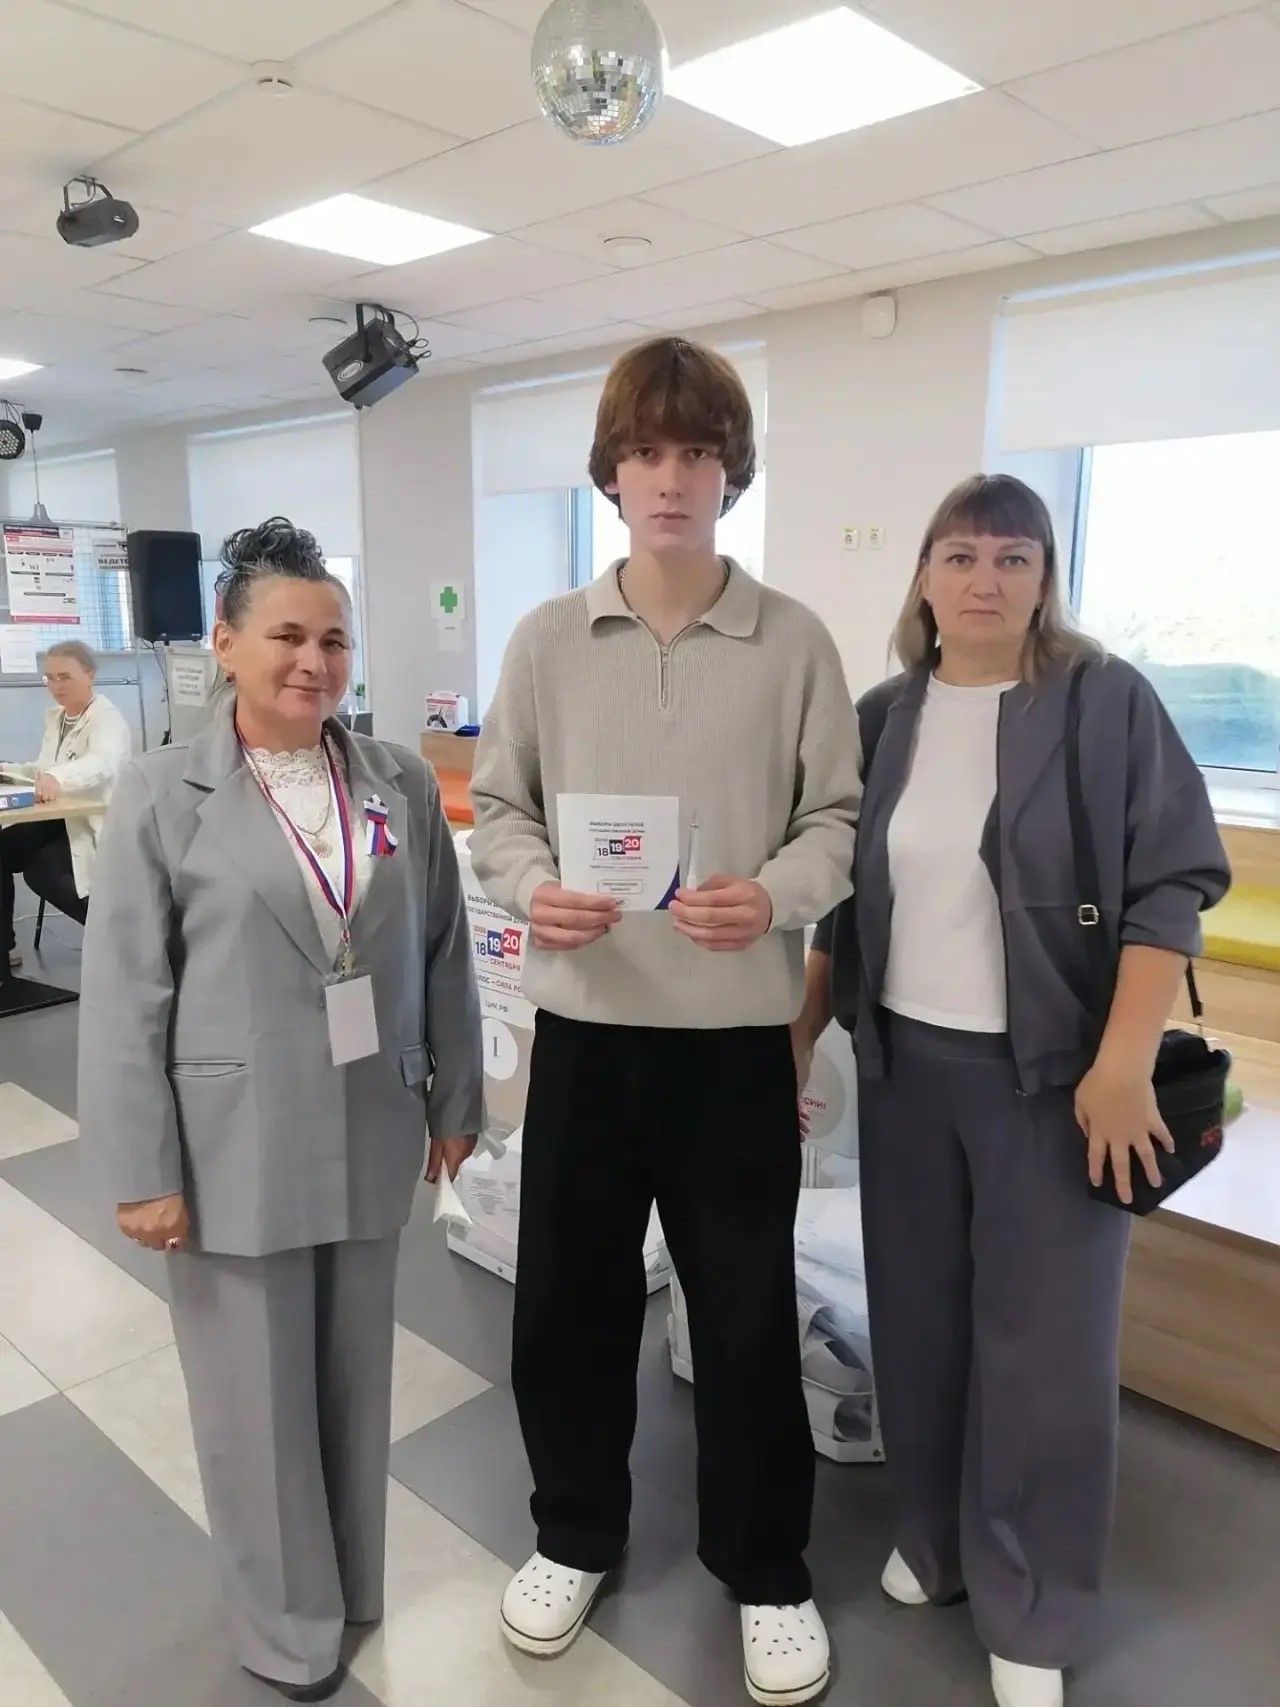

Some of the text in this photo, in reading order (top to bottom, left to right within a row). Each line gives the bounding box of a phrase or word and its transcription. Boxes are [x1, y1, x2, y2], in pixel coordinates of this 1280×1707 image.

[597, 839, 639, 856] 18 19 20
[475, 933, 519, 956] 18 19 20
